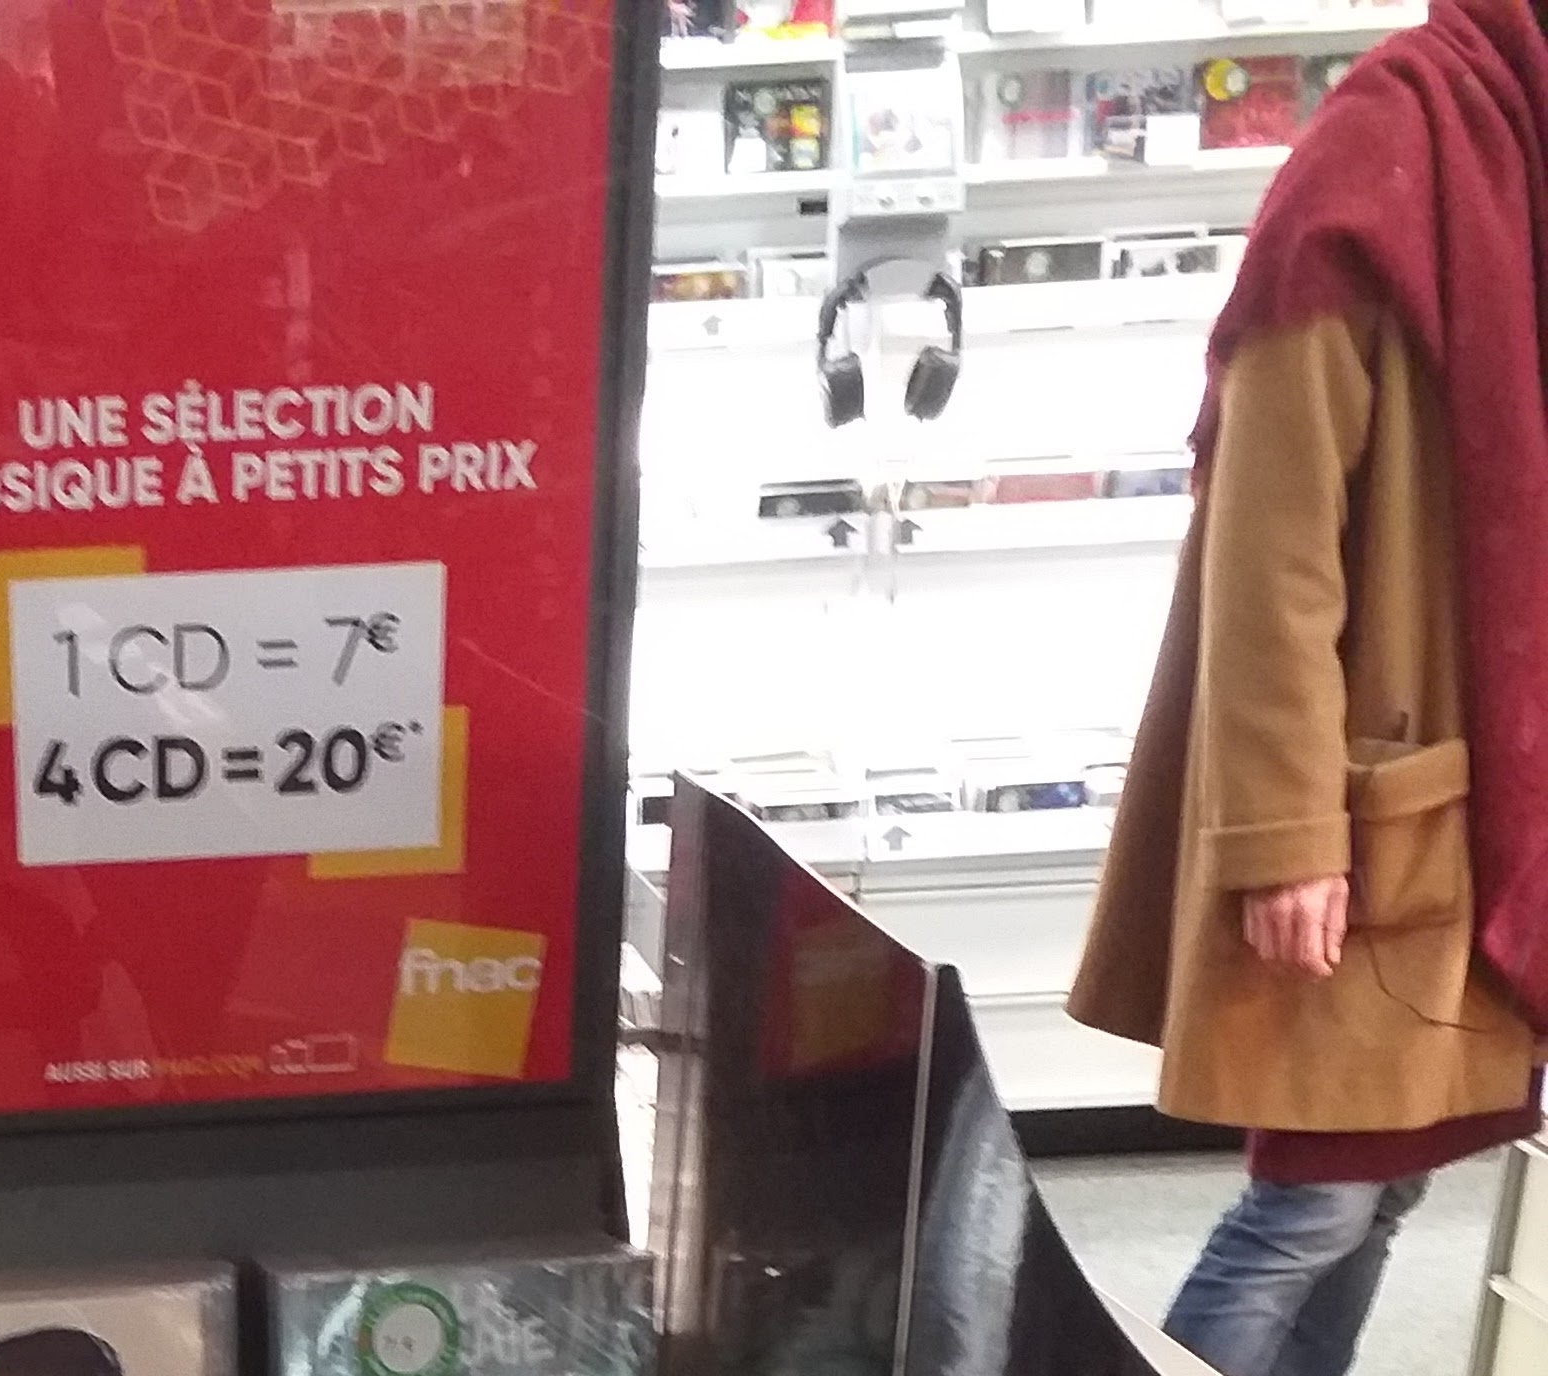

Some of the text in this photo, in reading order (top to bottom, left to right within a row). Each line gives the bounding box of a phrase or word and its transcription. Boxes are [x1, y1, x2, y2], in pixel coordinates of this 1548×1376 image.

[17, 378, 435, 449] UNE SÉLECTION
[175, 445, 220, 505] À
[232, 445, 405, 502] PETITS
[417, 438, 539, 496] PRIX
[53, 627, 82, 699] 1
[107, 622, 232, 695] CD
[397, 946, 543, 998] fnac
